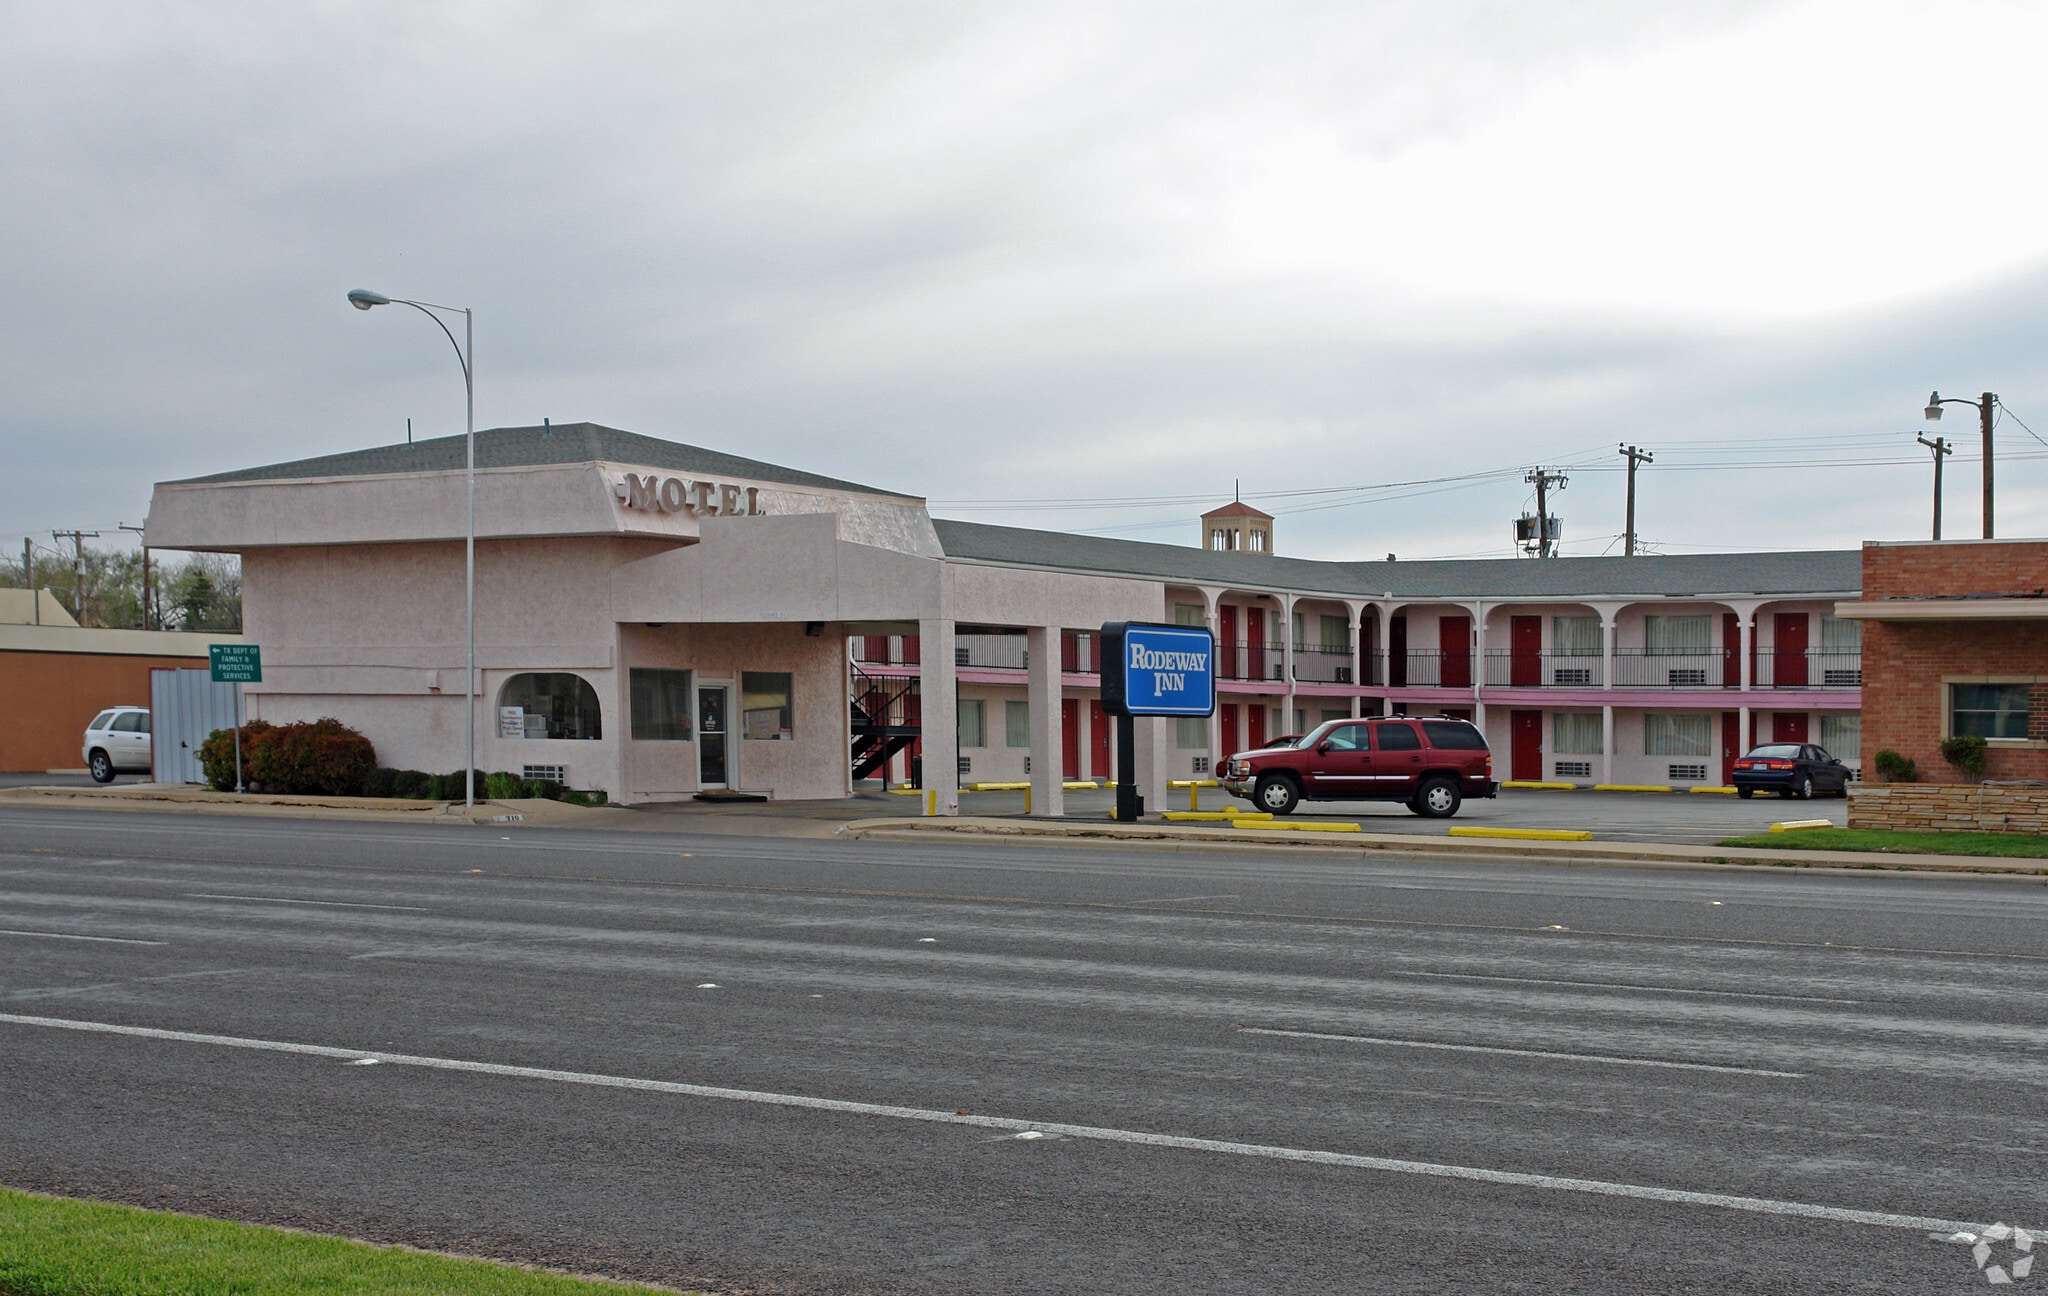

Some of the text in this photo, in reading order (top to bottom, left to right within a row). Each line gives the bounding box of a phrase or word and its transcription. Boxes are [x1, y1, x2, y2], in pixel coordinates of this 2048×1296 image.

[622, 473, 766, 516] MOTEL
[221, 655, 243, 663] FAMILY
[1130, 643, 1207, 671] RODEWAY
[222, 672, 251, 680] SERVICES
[1153, 672, 1185, 697] INN
